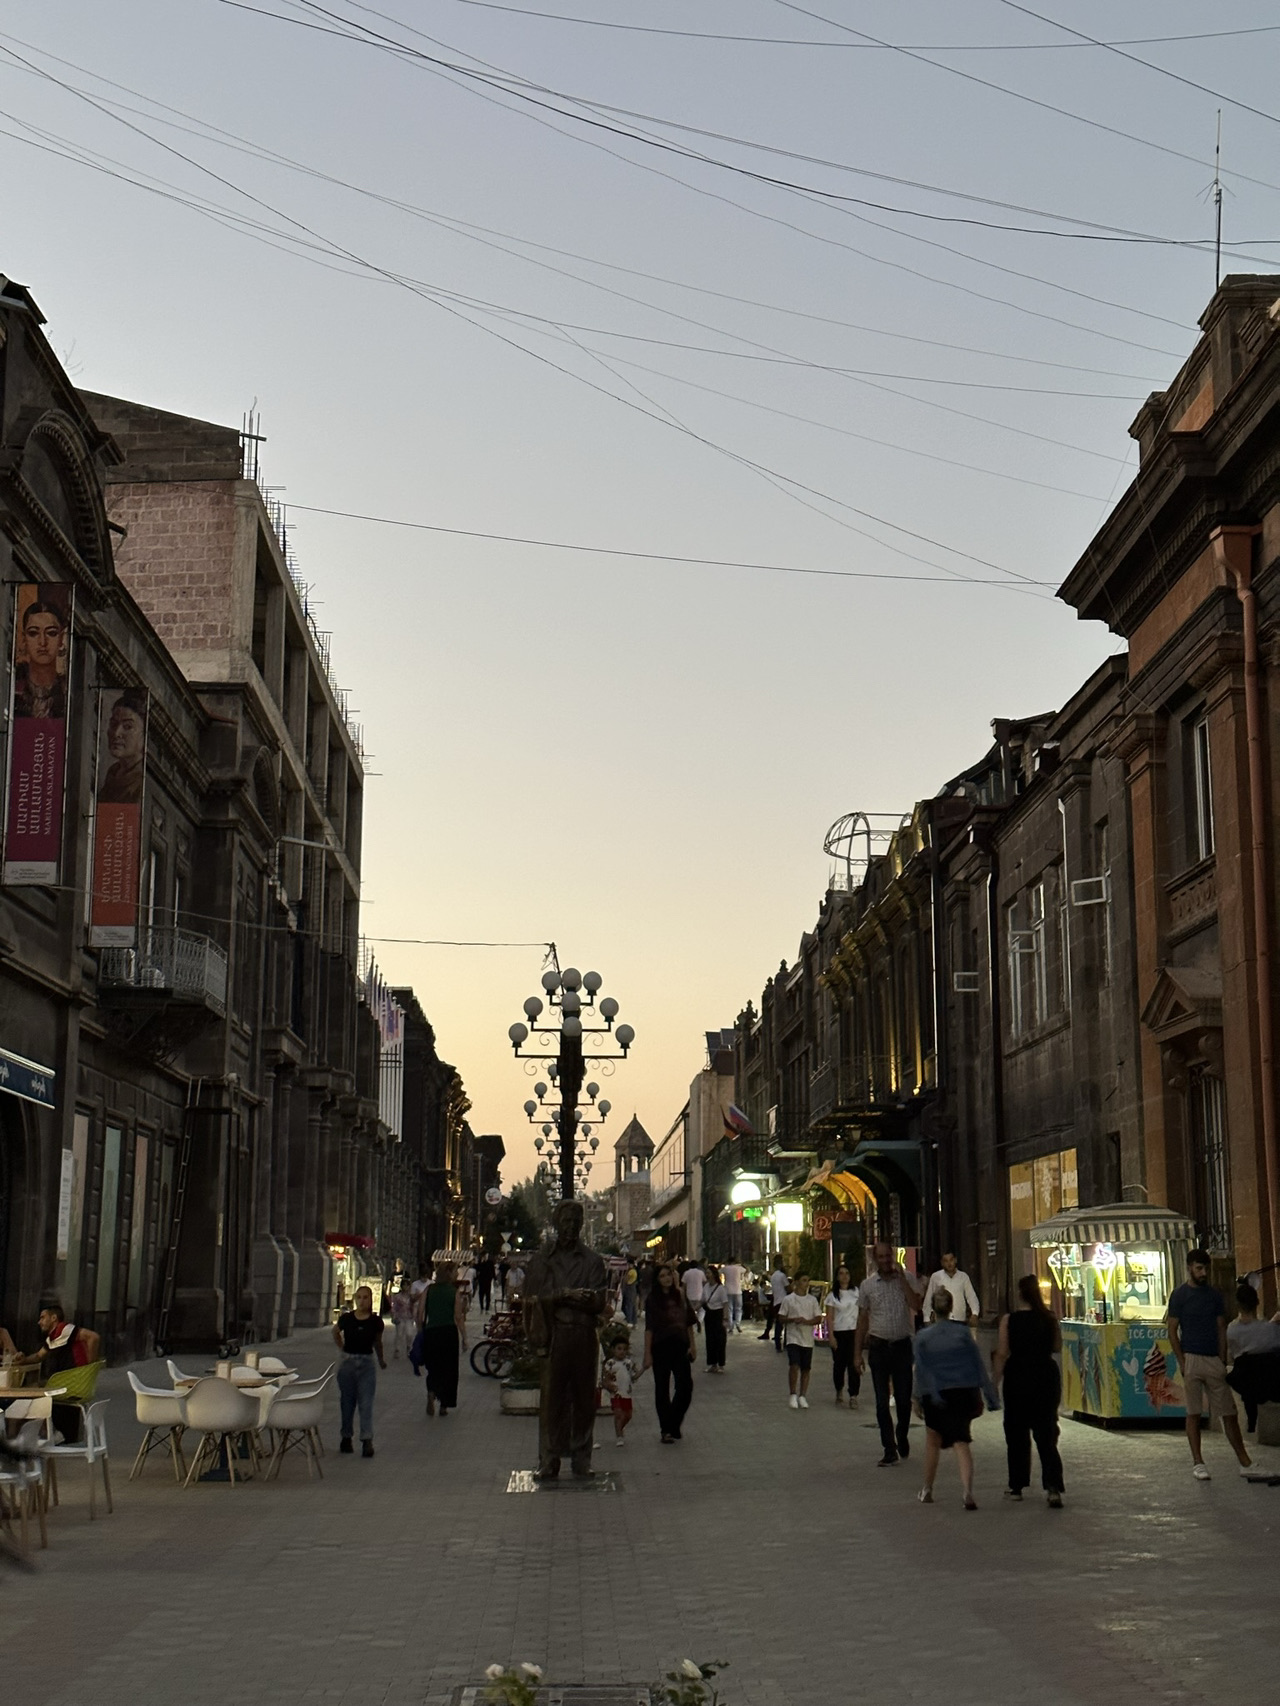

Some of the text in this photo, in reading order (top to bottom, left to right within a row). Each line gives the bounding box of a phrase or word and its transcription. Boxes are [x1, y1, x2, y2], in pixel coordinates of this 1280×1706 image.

[17, 770, 30, 835] ՄԱՐԻԱՄ
[29, 732, 45, 835] ԱՍԼԱՄԱԶՅԱՆ
[44, 736, 56, 835] MARIAM ASLAMAZYAN
[1128, 1328, 1145, 1339] ICE
